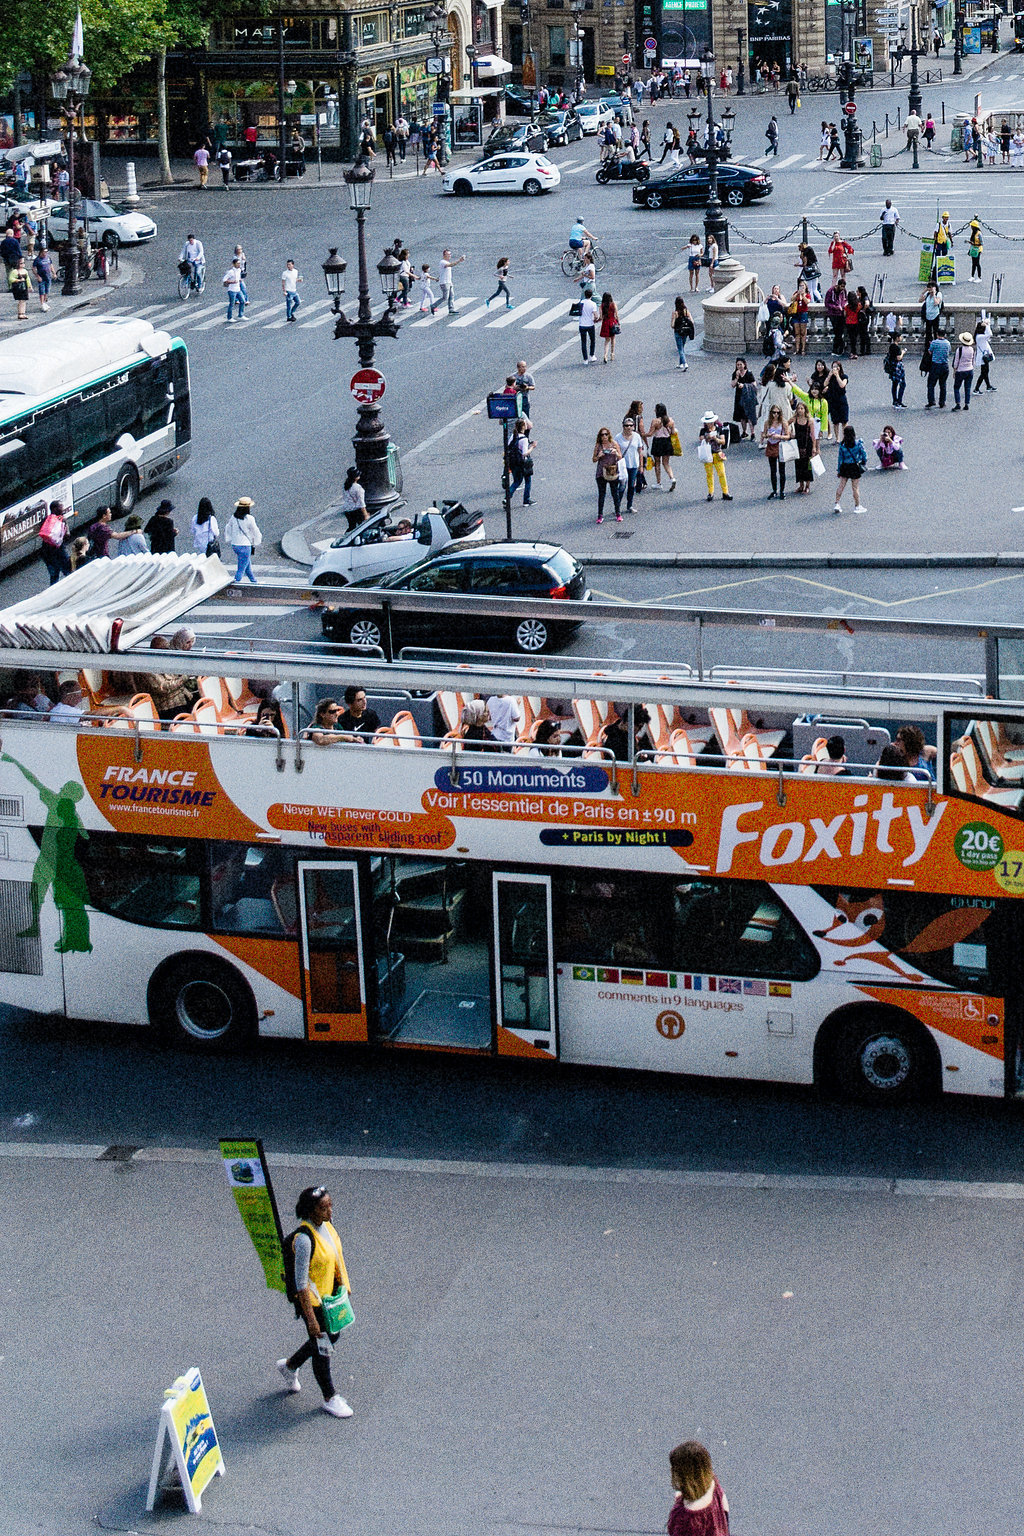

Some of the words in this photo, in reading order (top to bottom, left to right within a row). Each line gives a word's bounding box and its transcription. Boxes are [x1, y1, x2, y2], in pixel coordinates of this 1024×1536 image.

[235, 28, 289, 38] MATY
[2, 511, 42, 543] ANNABELLE
[103, 765, 198, 787] FRANCE
[462, 770, 483, 786] 50
[488, 770, 586, 789] Monuments
[100, 783, 217, 807] TOURISME
[109, 803, 200, 818] www.francetourisme.fr
[282, 804, 314, 817] Never
[316, 806, 343, 818] WET
[345, 809, 376, 821] never
[378, 811, 412, 823] COLD
[425, 791, 459, 809] Voir
[462, 793, 544, 814] l'essentiel
[548, 799, 569, 816] de
[573, 801, 614, 820] Paris
[618, 807, 639, 821] en
[680, 811, 698, 825] m
[307, 820, 328, 832] New
[330, 821, 358, 833] buses
[361, 822, 381, 833] with
[716, 792, 949, 874] Foxity
[309, 830, 374, 844] transparent
[378, 831, 415, 846] sliding
[573, 831, 605, 843] Paris
[607, 831, 623, 845] by
[625, 831, 660, 845] Night
[961, 829, 1001, 853] 20€
[597, 990, 658, 1004] comments
[660, 994, 672, 1005] in
[673, 995, 682, 1005] 9
[684, 996, 744, 1012] languages
